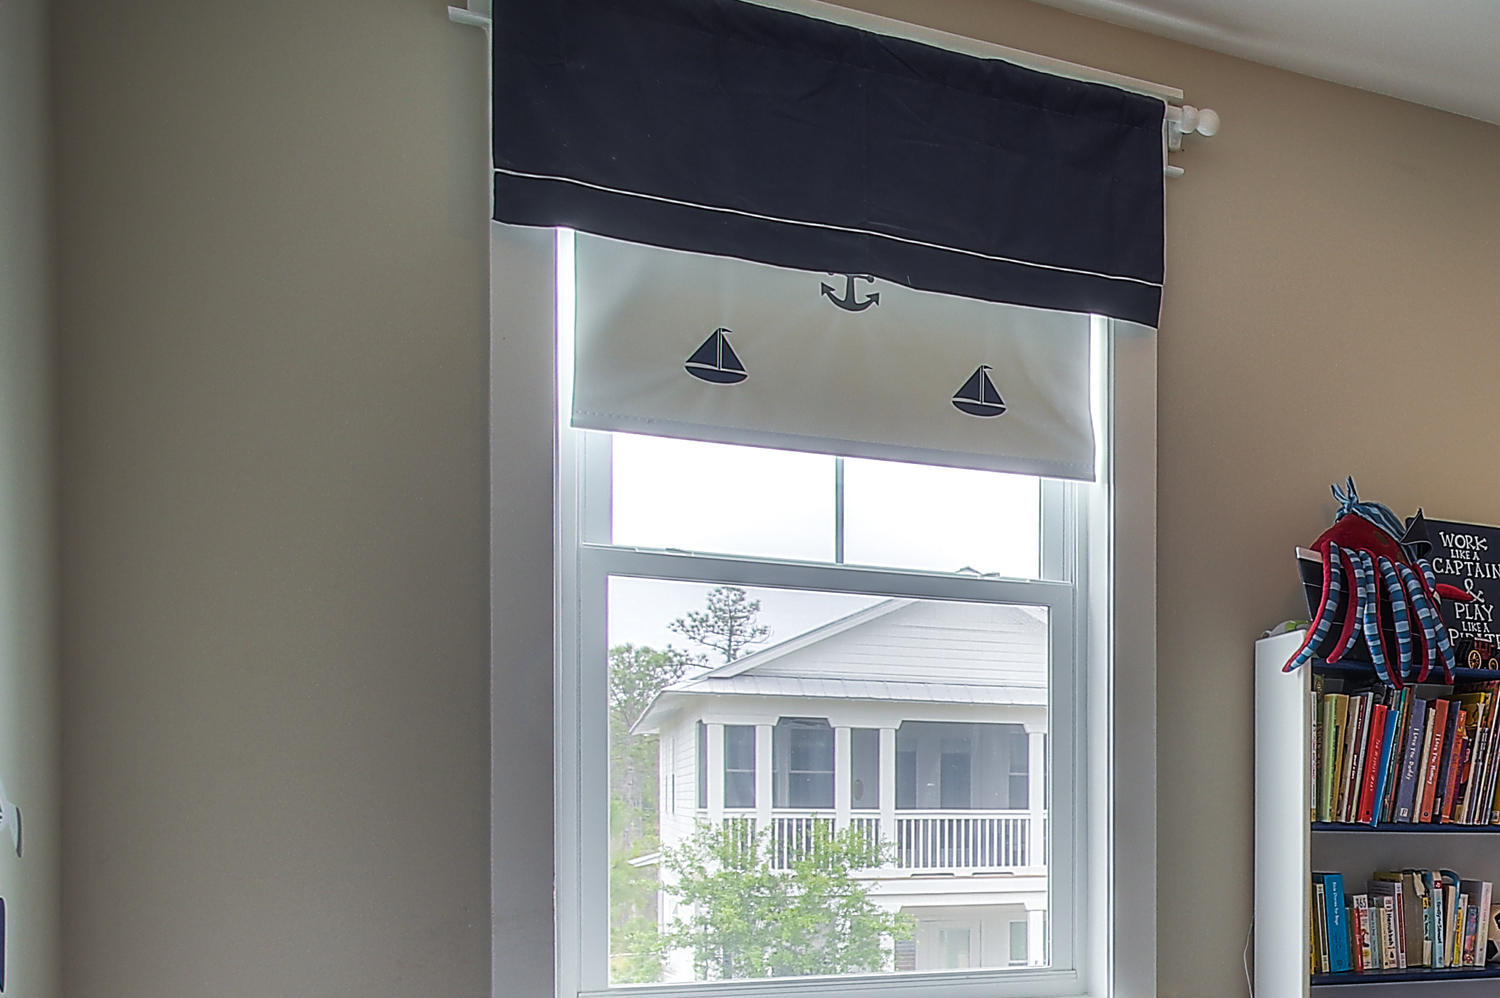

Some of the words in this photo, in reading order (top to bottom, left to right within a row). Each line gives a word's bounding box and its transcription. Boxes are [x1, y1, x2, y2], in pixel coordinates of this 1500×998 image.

[1438, 531, 1488, 551] WORK
[1450, 549, 1471, 560] LIKE
[1473, 551, 1480, 561] A
[1464, 578, 1485, 603] &
[1454, 602, 1494, 622] PLAY
[1461, 621, 1482, 632] LIKE
[1483, 622, 1490, 633] A
[1405, 761, 1415, 781] Daddy
